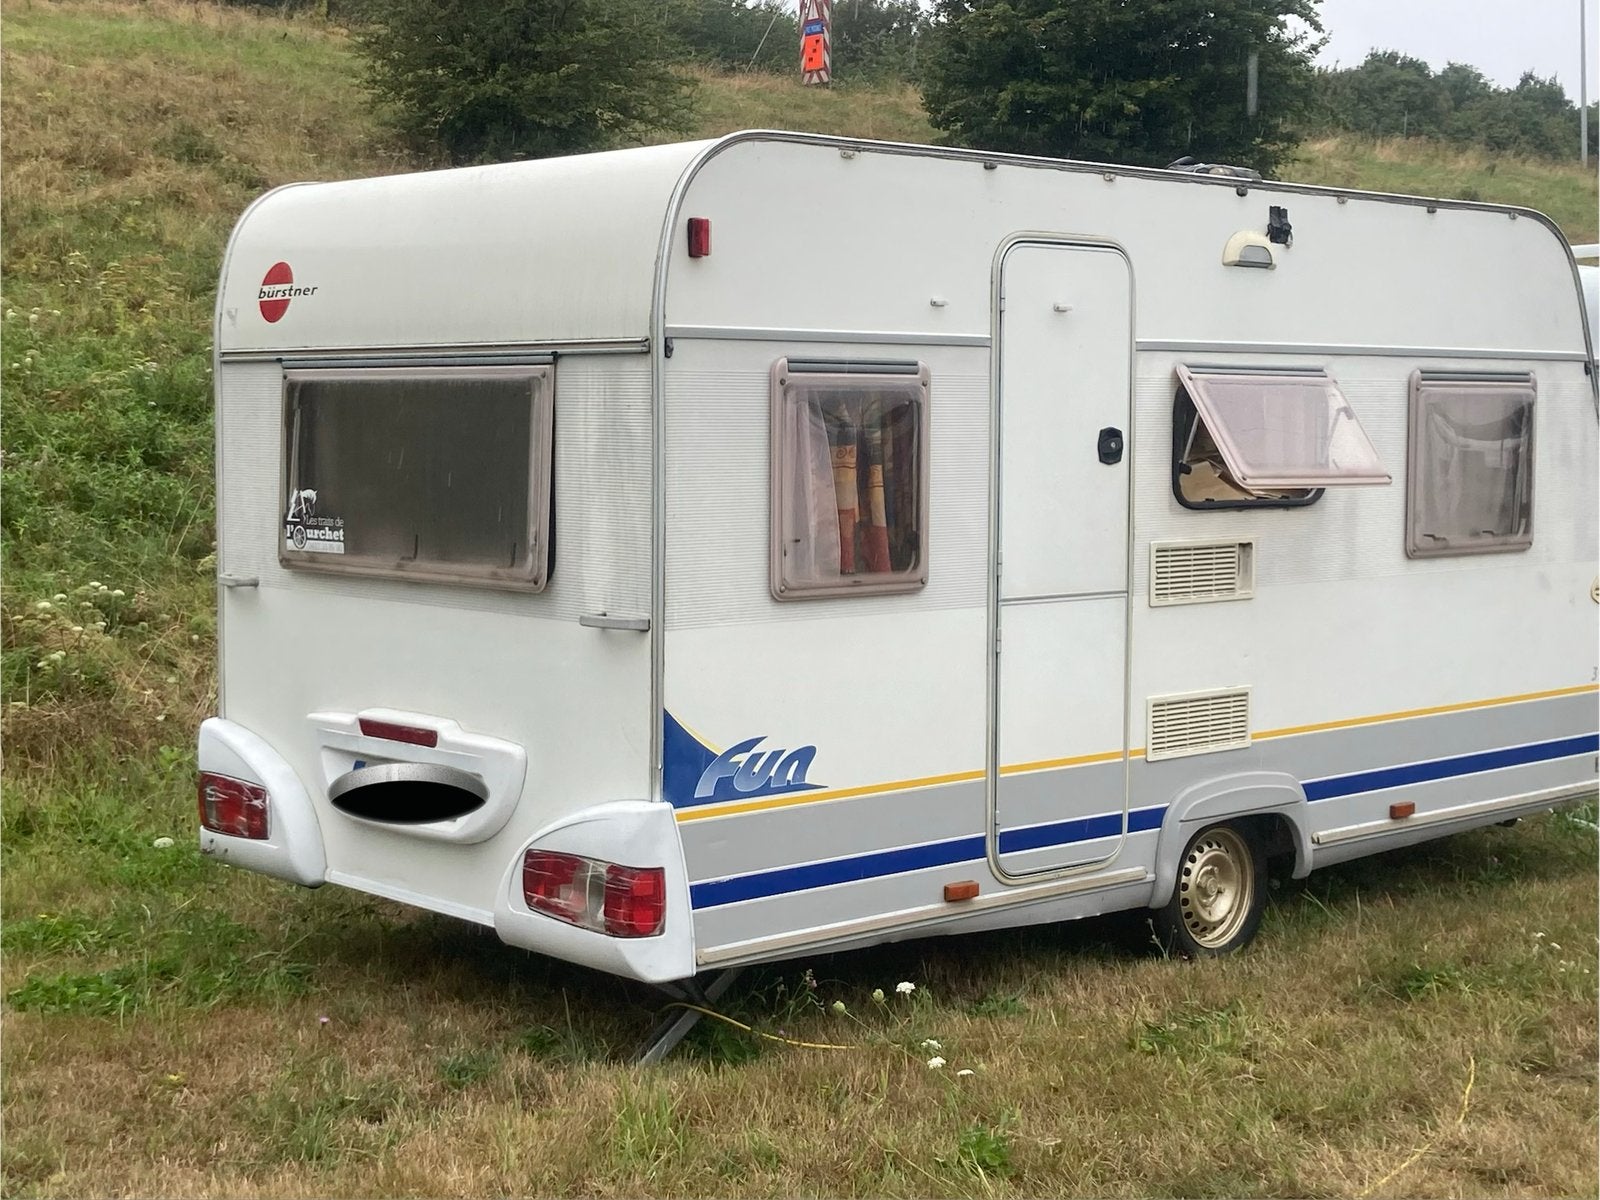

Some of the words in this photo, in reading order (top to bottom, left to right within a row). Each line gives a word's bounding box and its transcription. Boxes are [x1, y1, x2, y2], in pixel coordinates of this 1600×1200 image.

[258, 286, 318, 299] bürstner
[306, 515, 317, 525] Les
[335, 517, 344, 527] de
[694, 736, 817, 798] Fun
